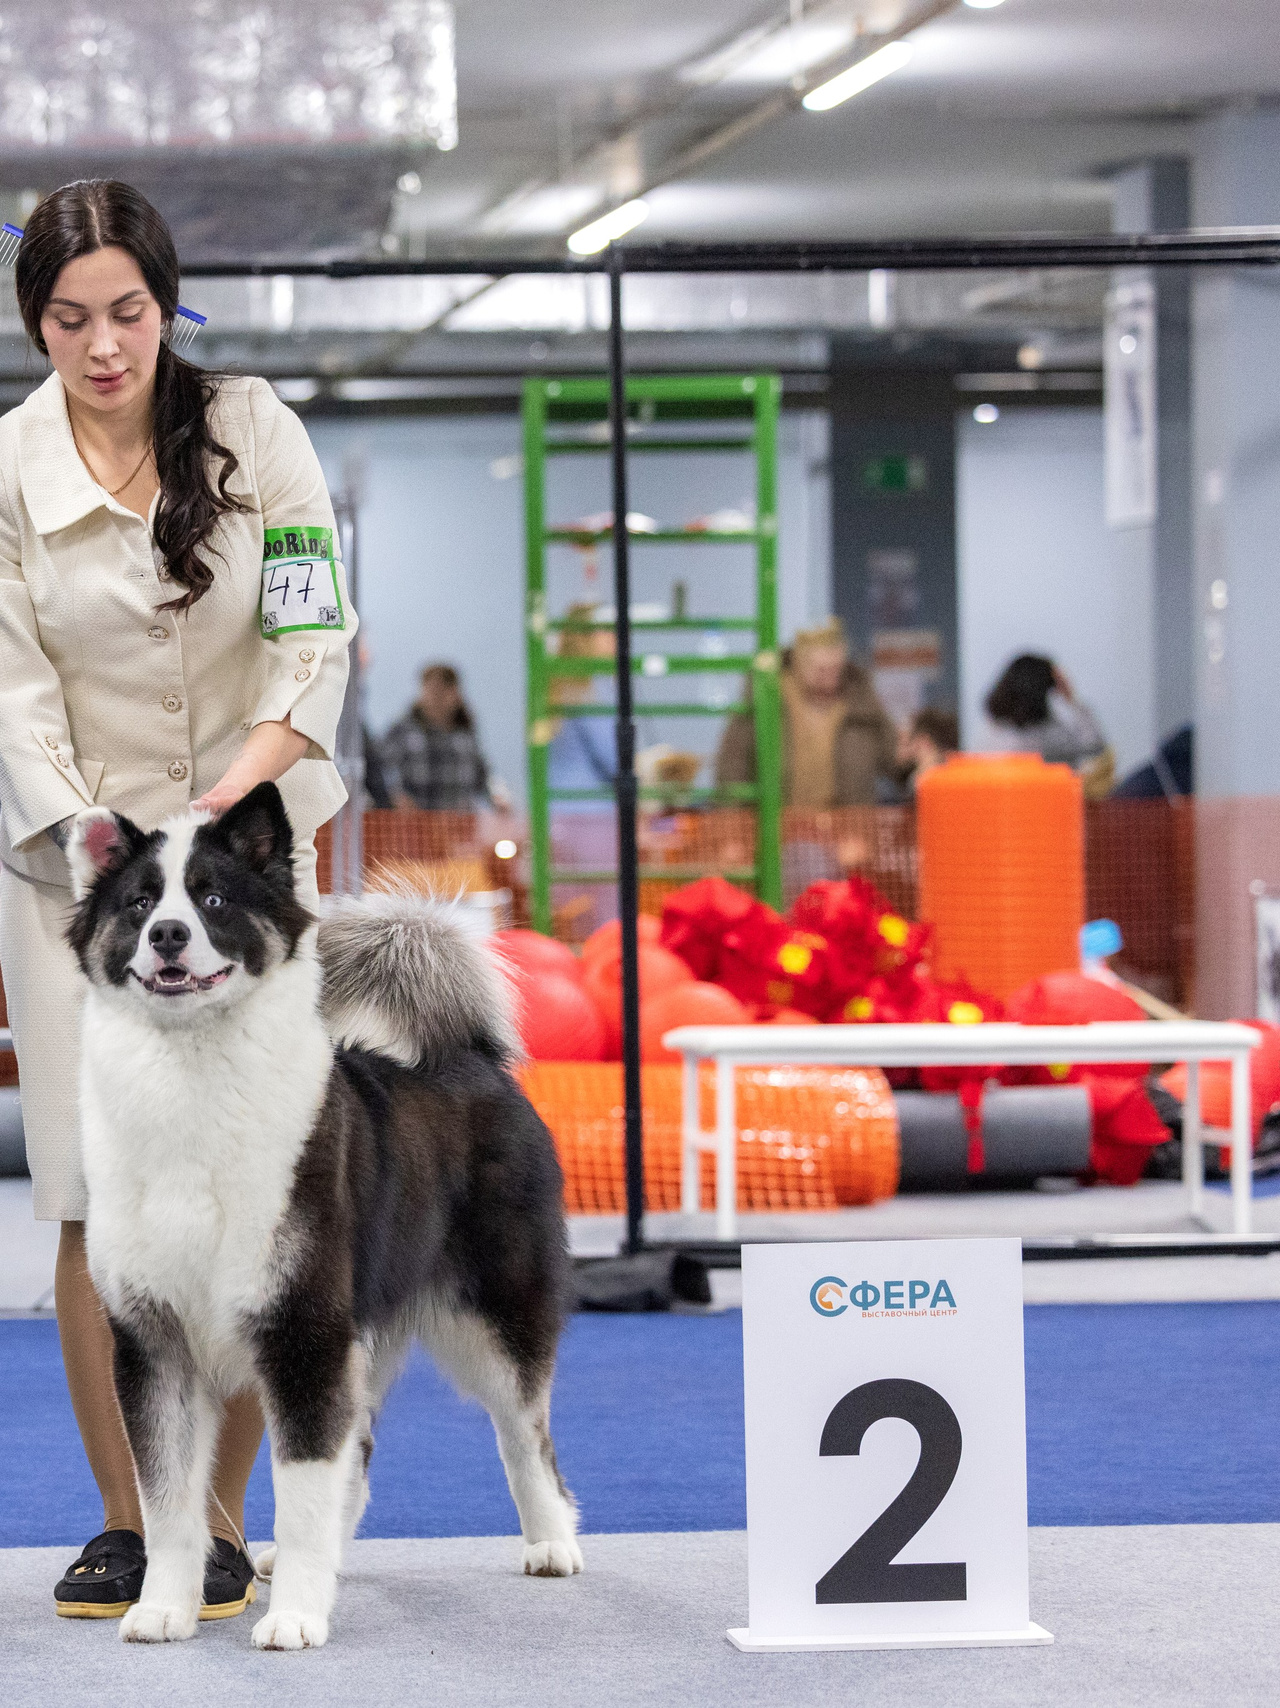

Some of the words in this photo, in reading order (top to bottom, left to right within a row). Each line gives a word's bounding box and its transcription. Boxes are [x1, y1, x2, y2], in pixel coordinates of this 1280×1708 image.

[268, 563, 315, 606] 47
[809, 1275, 957, 1318] СФЕРА
[862, 1309, 927, 1318] ВЫСТАВОЧНЫЙ
[930, 1309, 958, 1318] ЦЕНТР
[815, 1378, 967, 1604] 2
